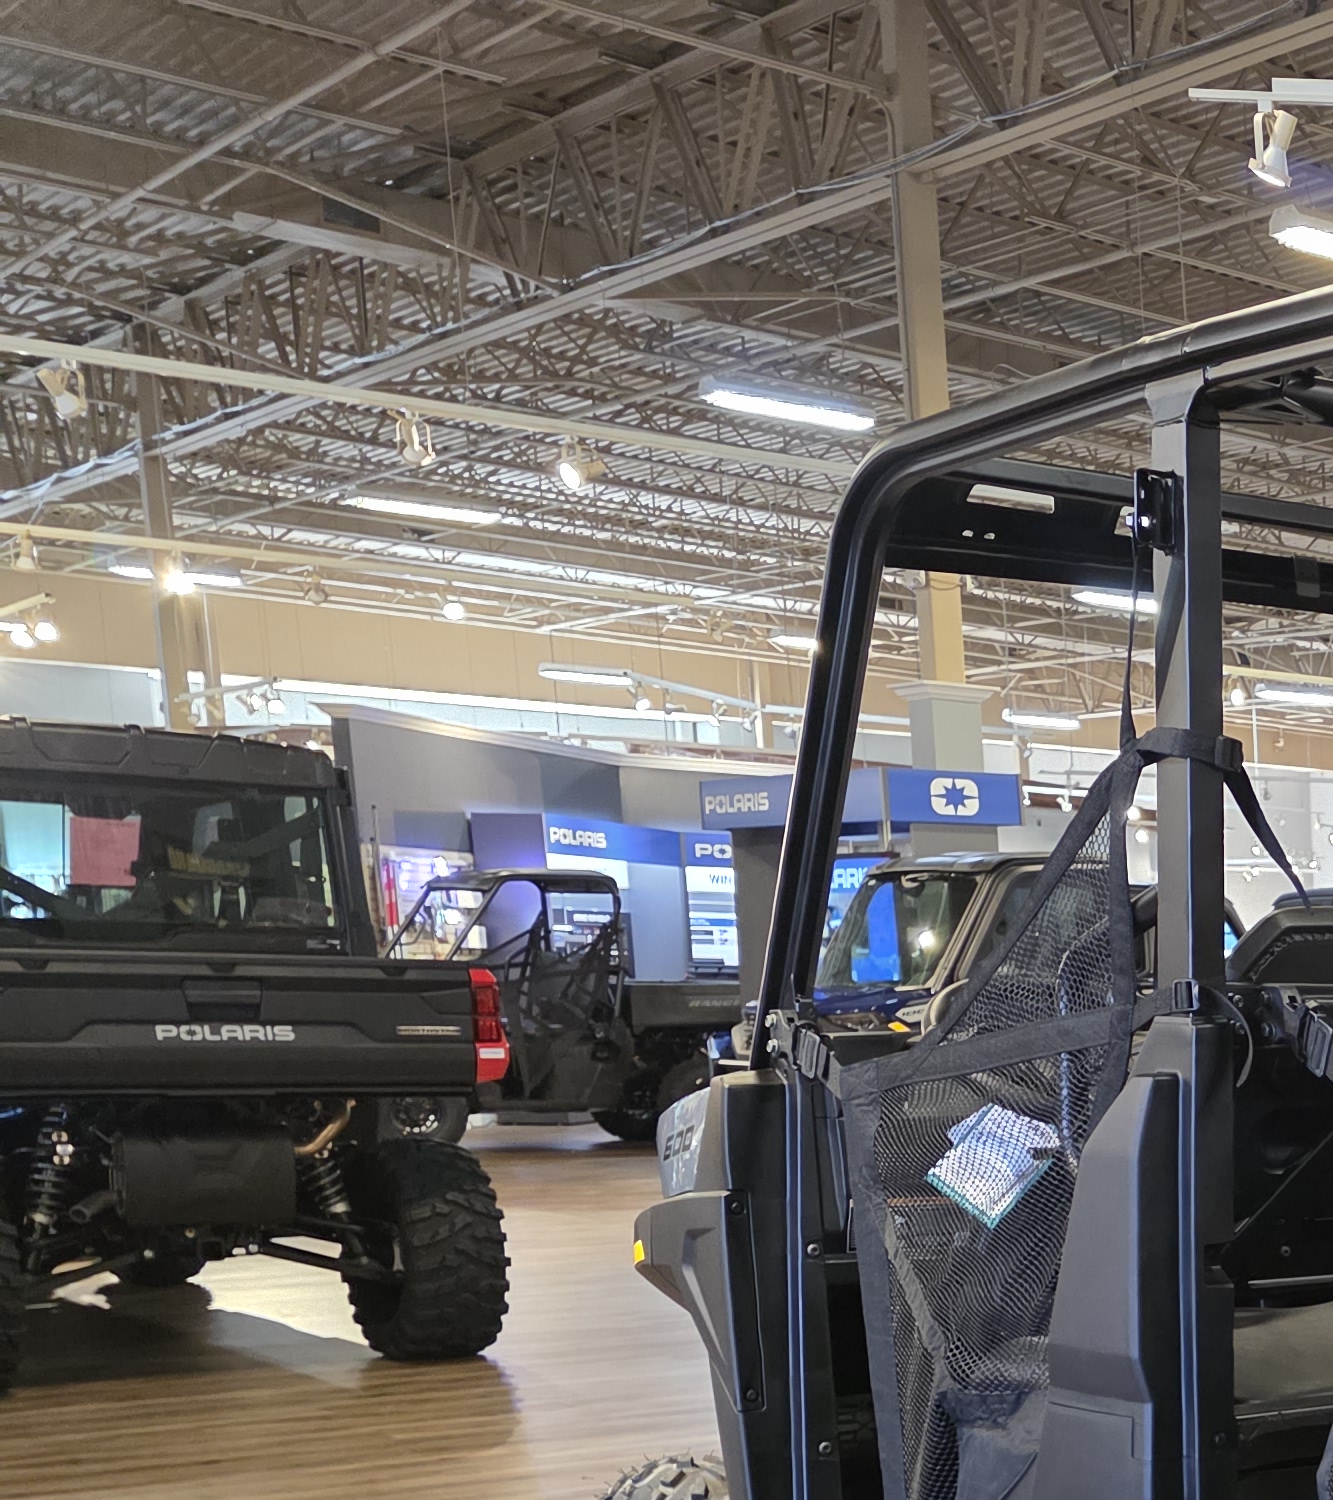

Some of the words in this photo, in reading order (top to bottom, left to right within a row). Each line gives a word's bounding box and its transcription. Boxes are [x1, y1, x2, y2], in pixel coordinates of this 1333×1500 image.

[704, 791, 770, 815] POLARIS
[549, 826, 607, 849] POLARIS
[154, 1024, 295, 1042] POLARIS
